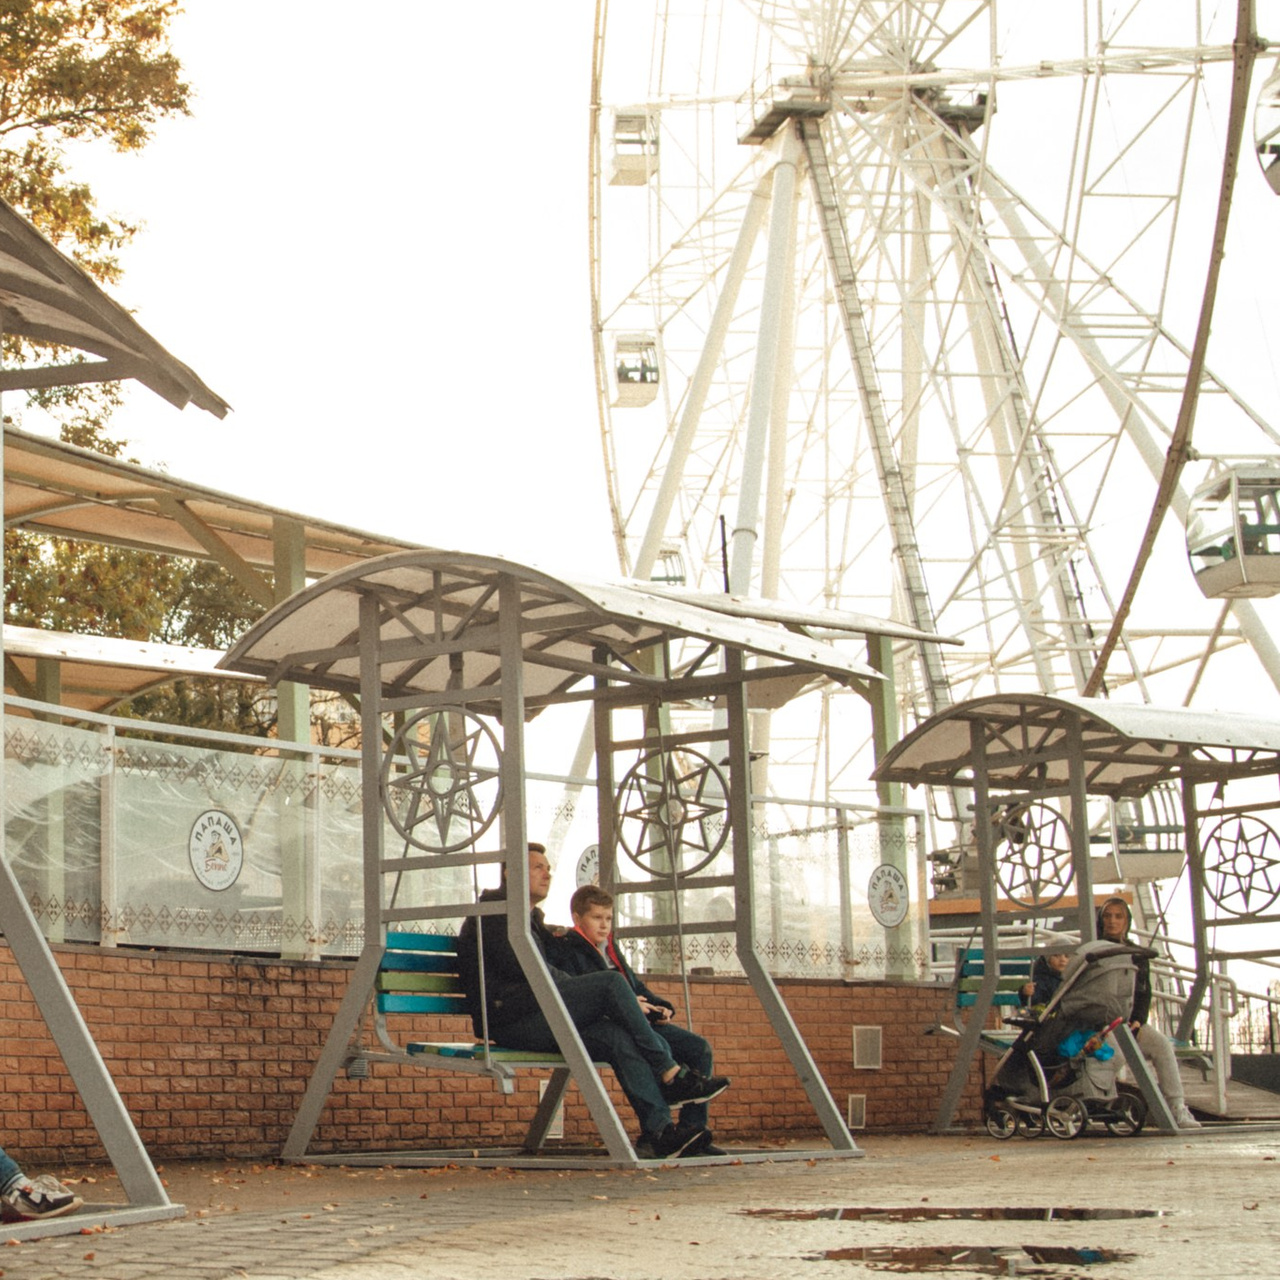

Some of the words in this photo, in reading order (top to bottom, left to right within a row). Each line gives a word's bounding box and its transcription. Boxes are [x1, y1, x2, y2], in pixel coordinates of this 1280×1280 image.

[195, 816, 237, 845] ПАПАША
[581, 849, 597, 873] ПАП
[872, 869, 904, 891] ПАПАША
